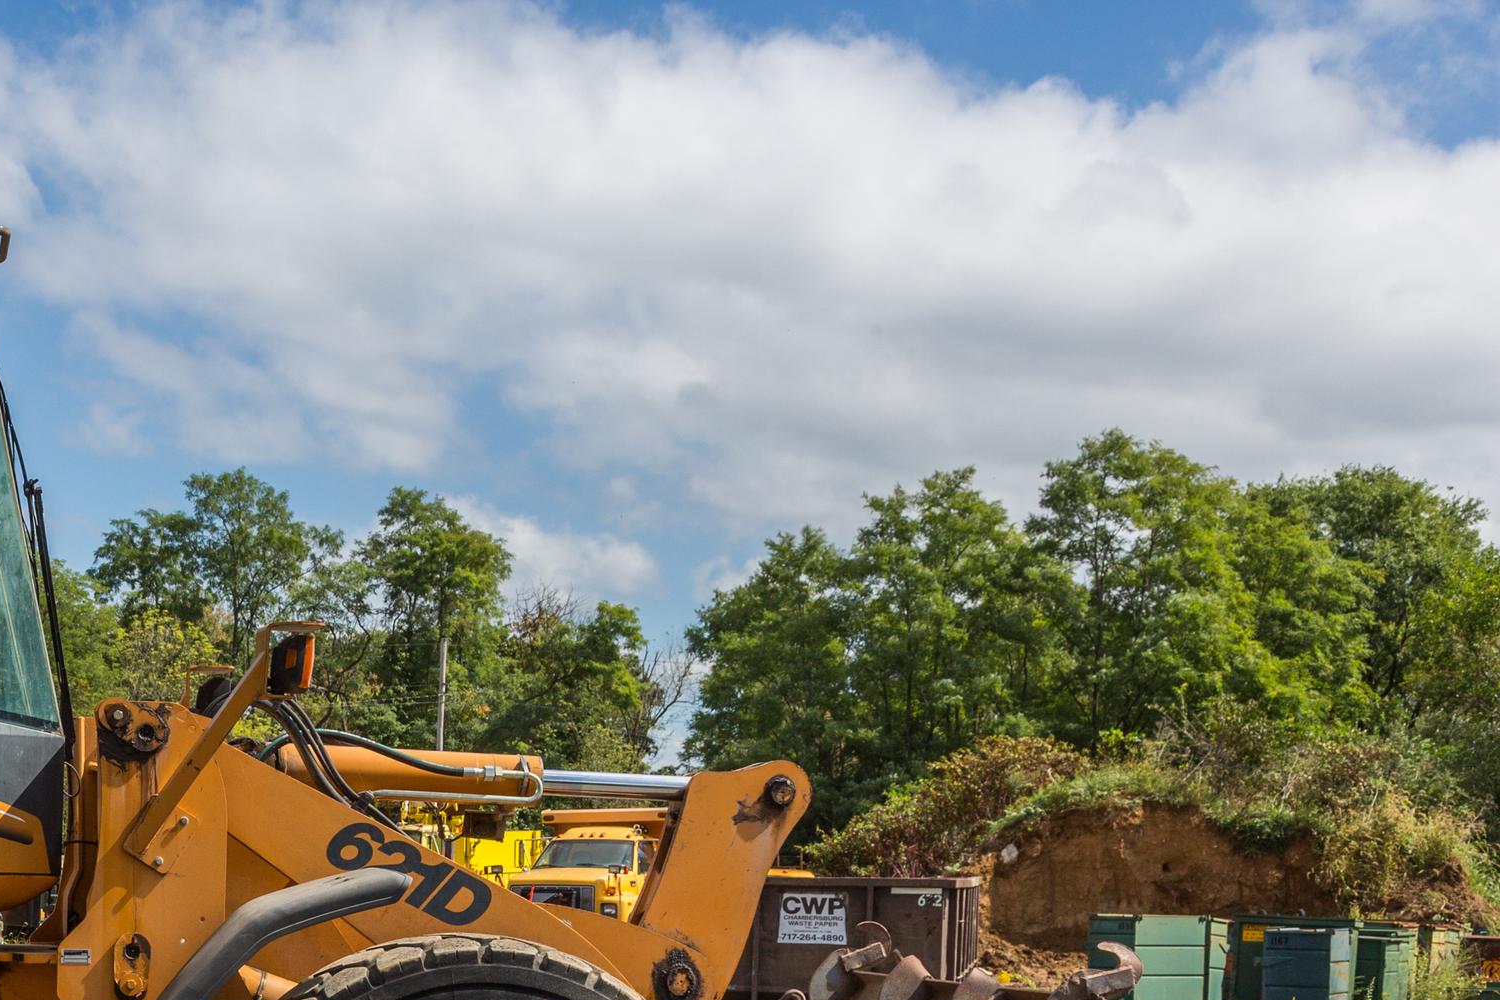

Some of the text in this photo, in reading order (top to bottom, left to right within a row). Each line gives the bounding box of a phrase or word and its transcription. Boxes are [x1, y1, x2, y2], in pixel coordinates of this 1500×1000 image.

[326, 822, 492, 926] 621D
[782, 896, 845, 915] CWP
[781, 933, 844, 942] 717-264-4890
